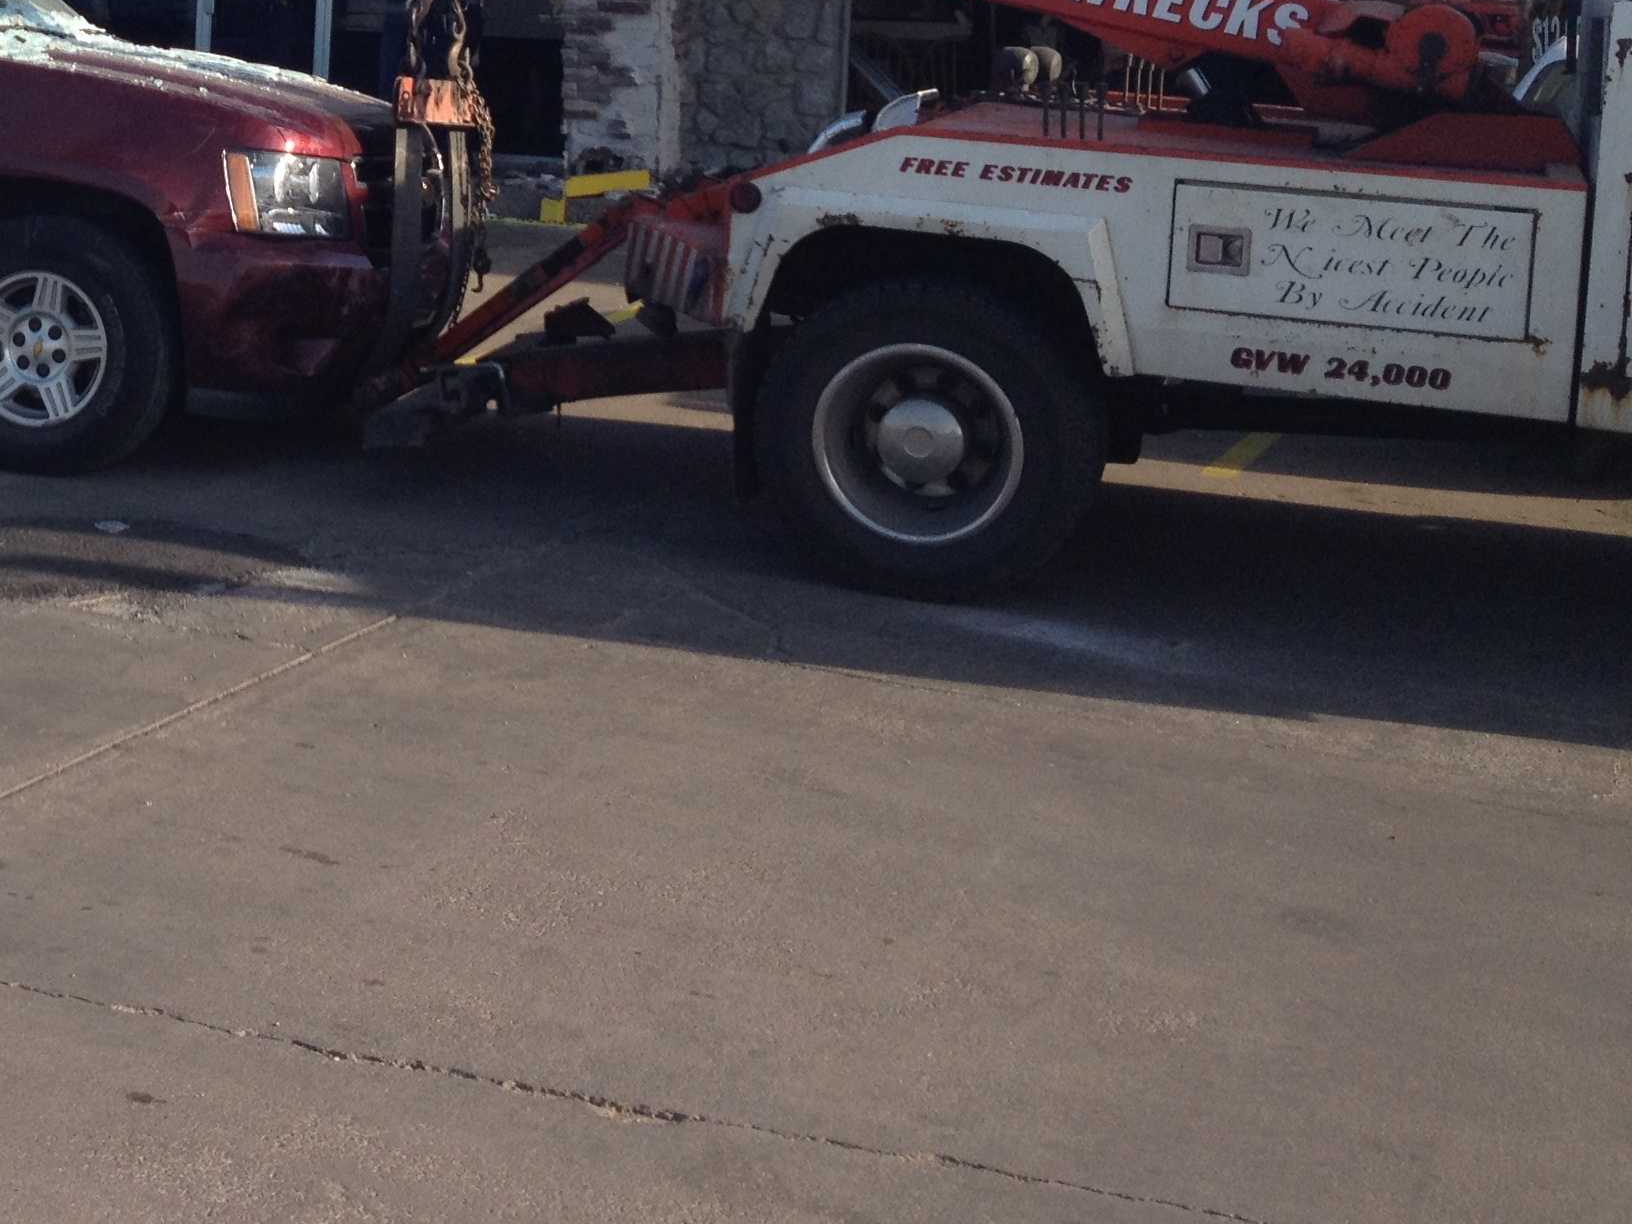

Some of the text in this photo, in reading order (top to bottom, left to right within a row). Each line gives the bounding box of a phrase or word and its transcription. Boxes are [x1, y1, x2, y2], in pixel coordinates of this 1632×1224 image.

[899, 156, 1134, 193] FREE ESTIMATES
[1264, 208, 1517, 251] We Meet The
[1261, 242, 1514, 289] Nicest People
[1276, 279, 1492, 323] By Accident
[1230, 347, 1452, 391] GVW 24,000
